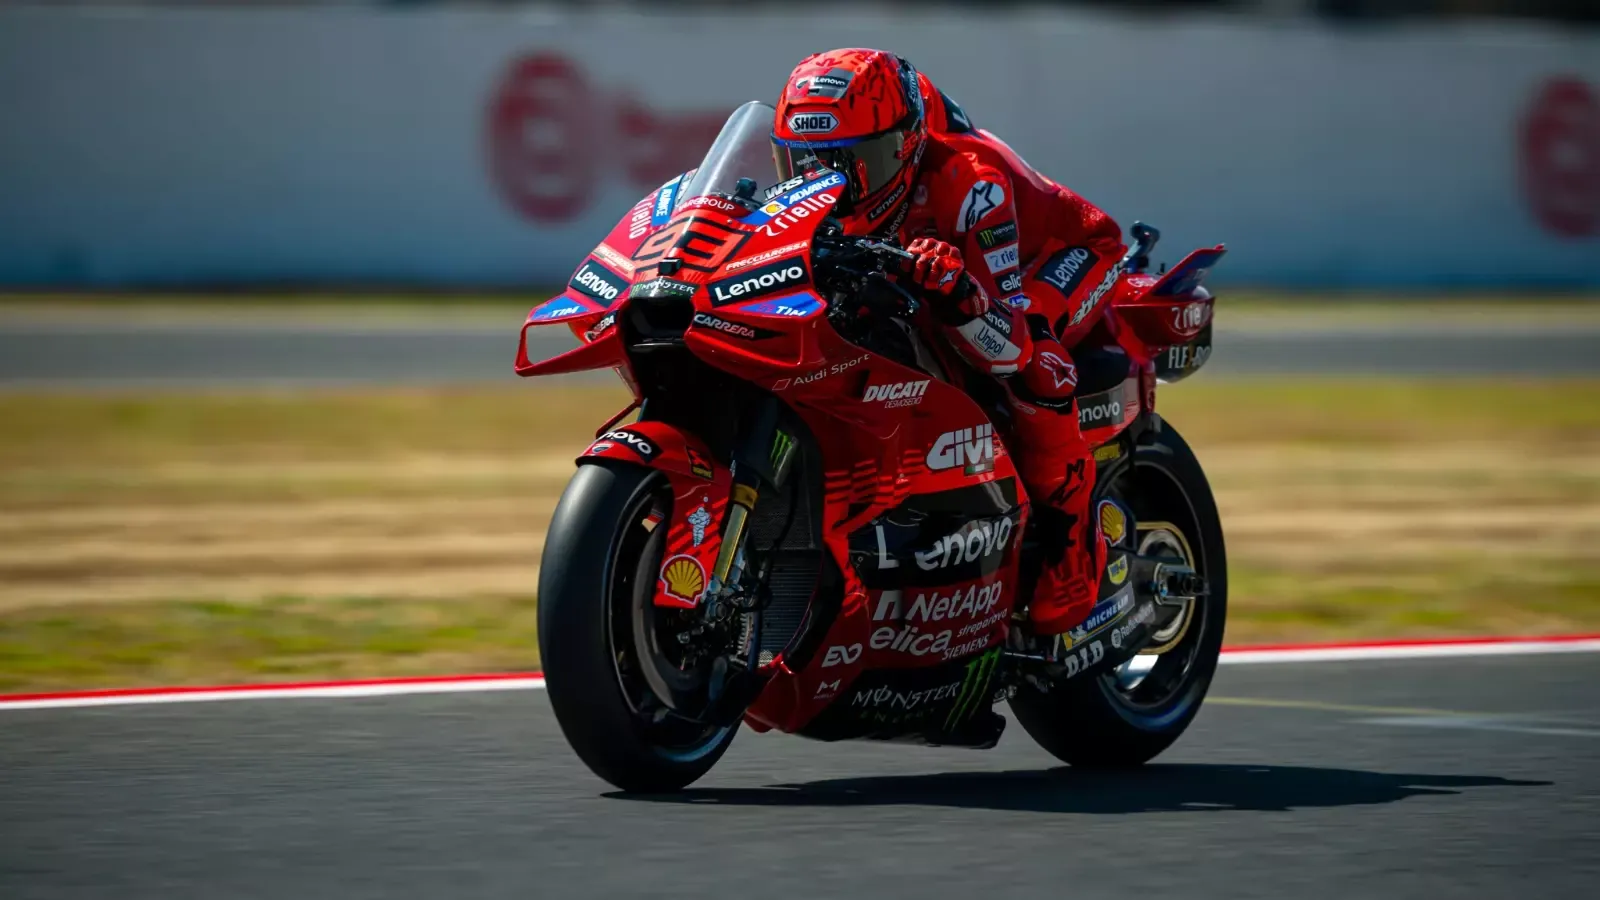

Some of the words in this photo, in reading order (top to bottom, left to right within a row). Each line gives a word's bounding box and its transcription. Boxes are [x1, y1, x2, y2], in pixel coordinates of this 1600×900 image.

[814, 75, 847, 87] Lenovo
[793, 115, 831, 131] SHOEI
[765, 174, 804, 201] WRS
[788, 174, 841, 204] ADVANCE
[869, 184, 905, 219] Lenovo
[630, 213, 753, 274] 93
[725, 241, 808, 271] FRECCIAROSSA
[574, 264, 618, 300] Lenovo
[714, 266, 803, 301] Lenovo
[1044, 248, 1090, 289] Lenovo
[551, 305, 580, 318] TIM
[694, 313, 755, 338] CARRERA
[985, 311, 1012, 334] enovo
[977, 325, 1007, 355] Unipol
[793, 370, 827, 386] Audi
[831, 353, 870, 375] Sport
[862, 379, 931, 403] DUCATI
[926, 422, 993, 472] GIVI
[904, 580, 1003, 623] NetApp
[869, 624, 953, 656] elica
[941, 632, 990, 661] SIEMENS
